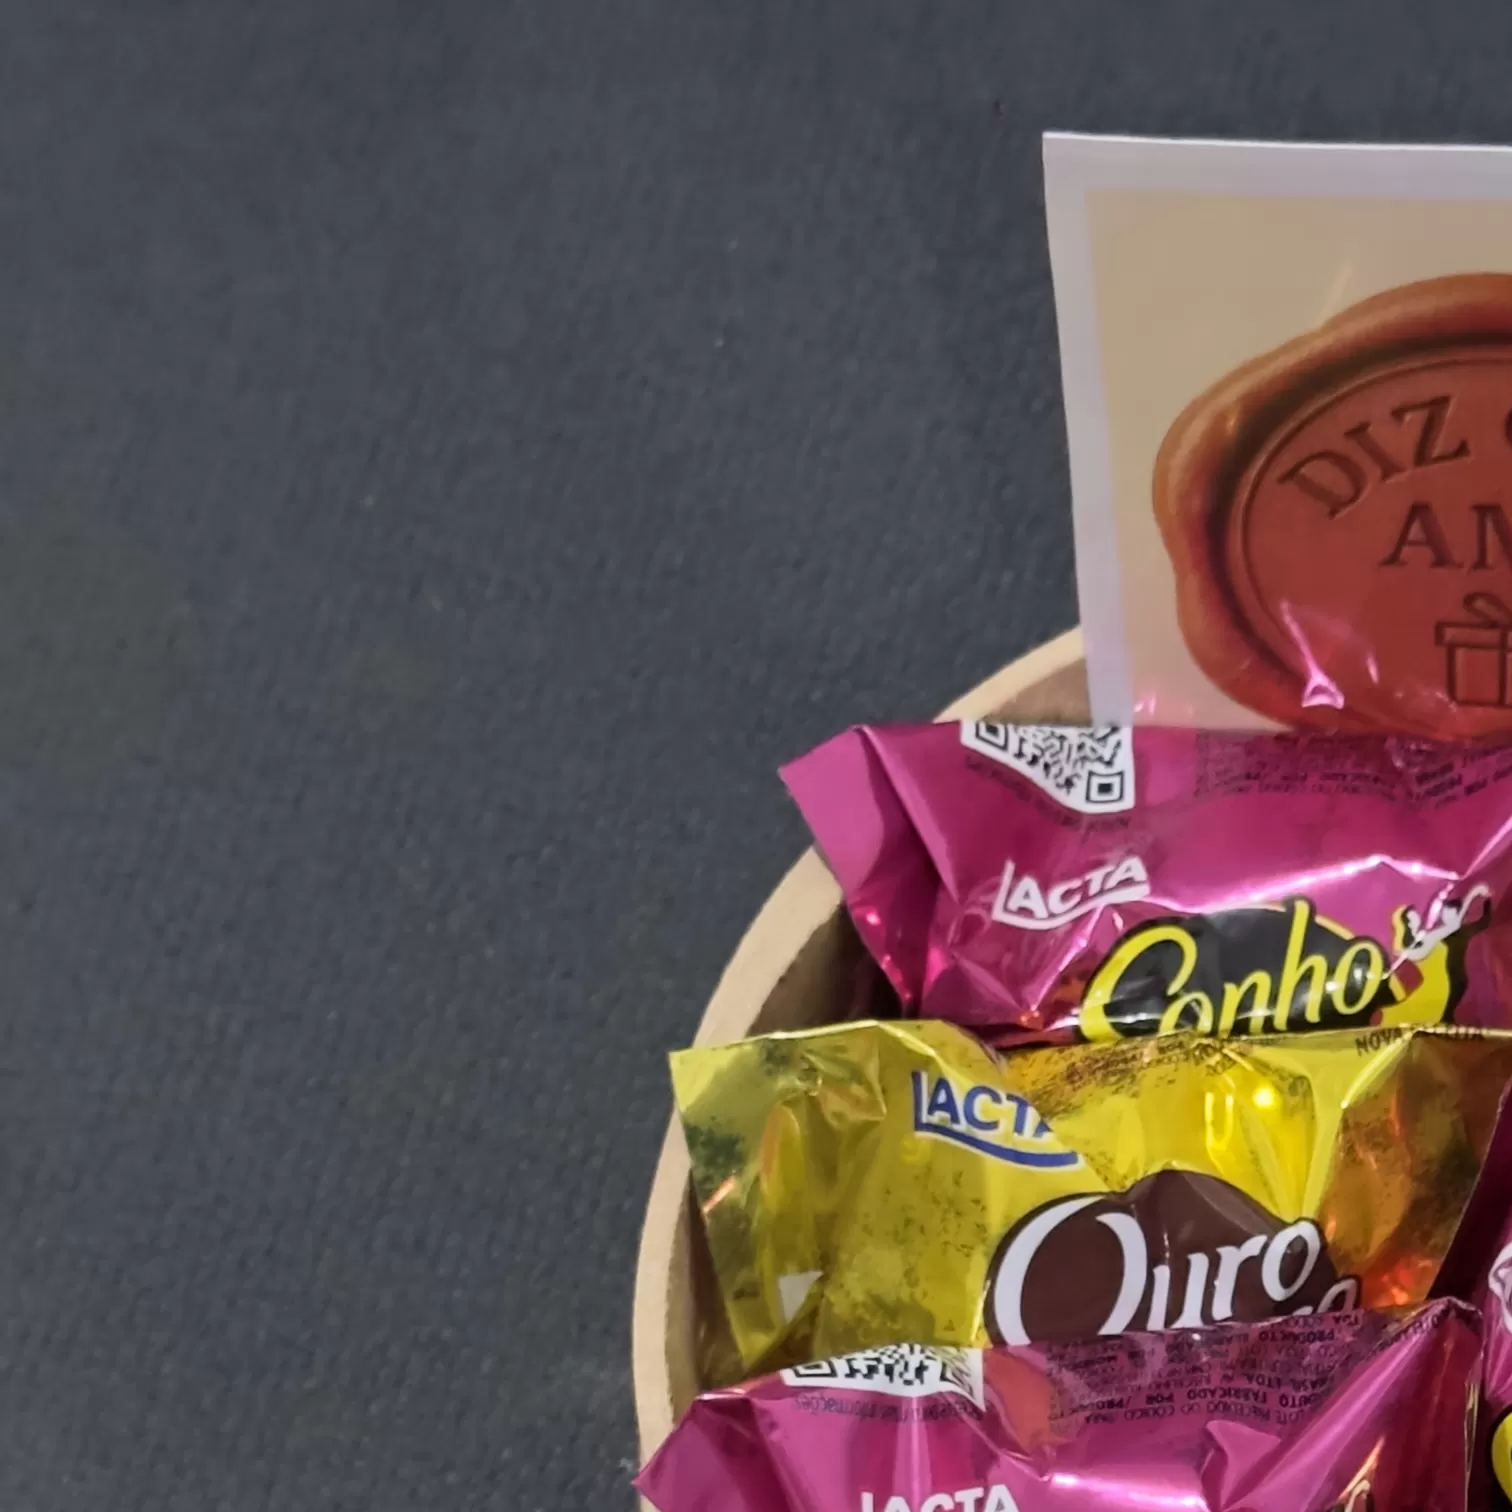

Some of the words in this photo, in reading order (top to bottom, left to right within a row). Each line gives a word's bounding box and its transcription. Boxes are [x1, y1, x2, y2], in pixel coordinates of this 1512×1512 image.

[1277, 396, 1470, 519] DIZ
[991, 856, 1150, 930] LACTA
[994, 1196, 1321, 1346] Ouro
